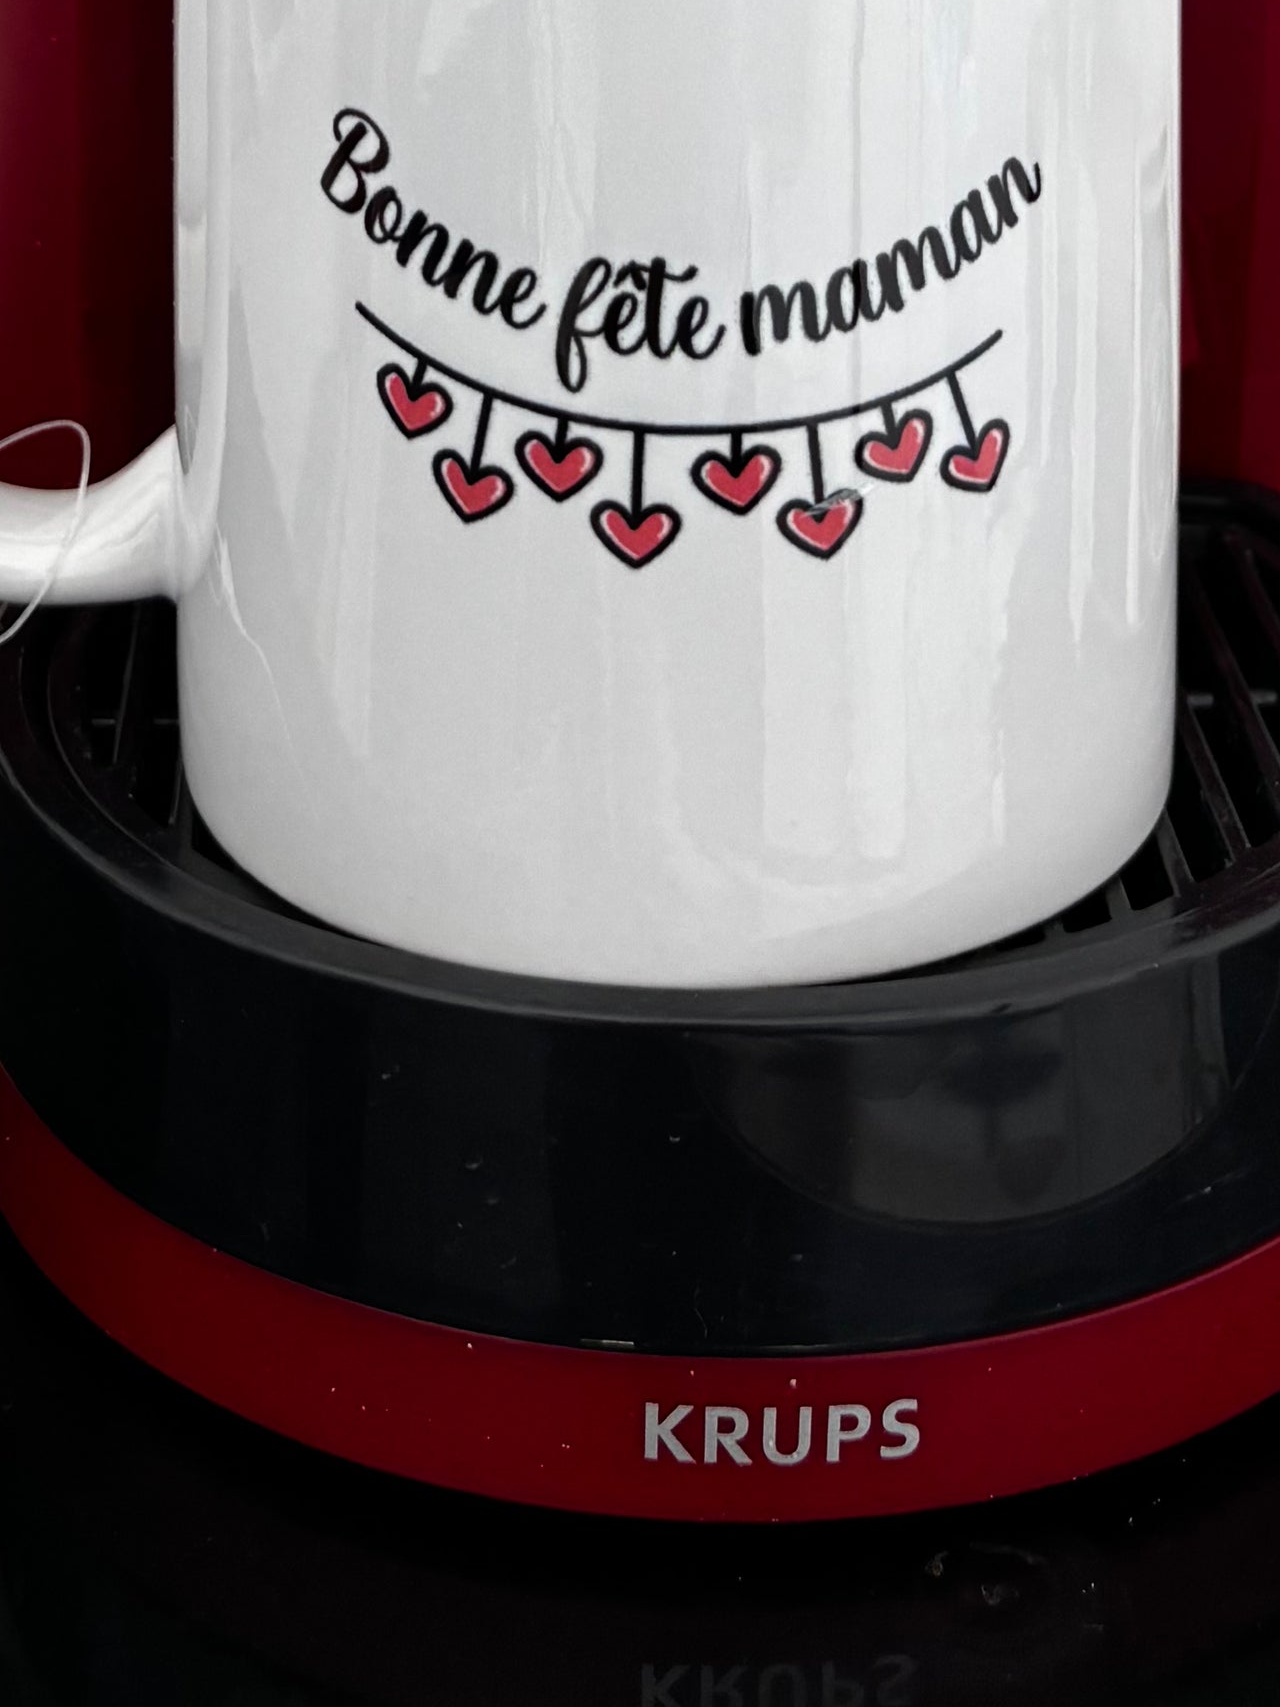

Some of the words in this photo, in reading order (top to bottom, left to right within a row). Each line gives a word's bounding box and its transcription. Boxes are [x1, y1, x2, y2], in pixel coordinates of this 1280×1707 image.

[320, 107, 546, 329] Bonne
[556, 256, 726, 393] fête
[741, 155, 1042, 356] maman
[644, 1398, 920, 1465] KRUPS
